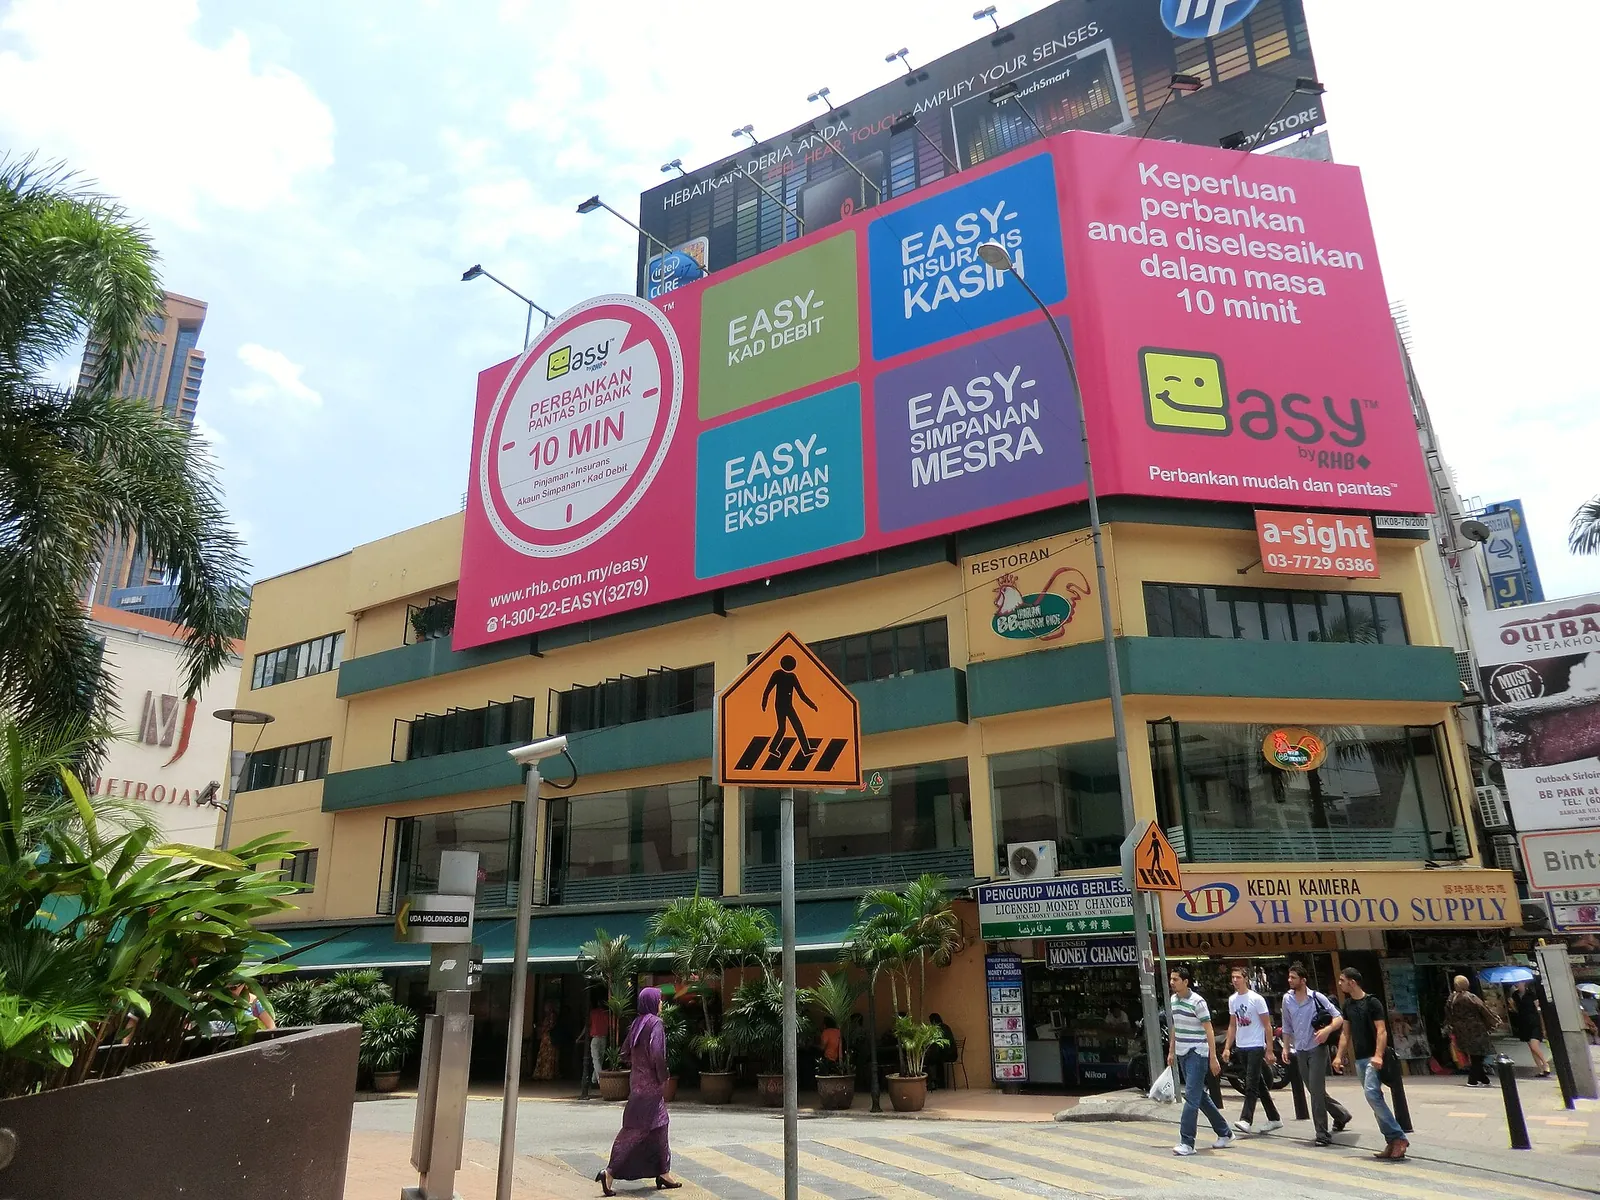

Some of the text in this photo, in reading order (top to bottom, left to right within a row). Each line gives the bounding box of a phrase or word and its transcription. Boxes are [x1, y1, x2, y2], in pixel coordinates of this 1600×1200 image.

[912, 77, 975, 115] AMPLIFY
[980, 54, 1027, 84] YOUR
[1033, 21, 1104, 62] SENSES.
[748, 146, 793, 175] DERIA
[798, 121, 853, 153] ANDA.
[1138, 162, 1296, 203] Keperluan
[901, 200, 1018, 266] EASY-
[1140, 197, 1305, 234] perbankan
[1088, 221, 1364, 270] anda diselesaikan
[903, 249, 1025, 319] KASIH
[1140, 253, 1326, 296] dalam masa
[728, 289, 824, 347] EASY-
[1177, 287, 1301, 324] 10 minit
[728, 316, 825, 367] KAD DEBIT
[528, 385, 632, 432] PANTAS DI BANK
[529, 366, 633, 419] PERBANKAN
[907, 364, 1036, 430] EASY-
[528, 411, 624, 470] 10 MIN
[910, 398, 1040, 454] SIMPANAN
[533, 457, 611, 489] Pinjaman Insurans
[725, 433, 828, 491] EASY-
[911, 426, 1044, 488] MESRA
[1298, 446, 1355, 470] by RHB
[516, 462, 628, 507] Akaun Simpanan Kad Debit
[725, 464, 829, 511] PINJAMAN
[1149, 465, 1238, 487] Perbankan
[1242, 475, 1299, 491] mudah
[1303, 477, 1333, 494] dan
[1337, 482, 1391, 497] pantas
[724, 486, 830, 533] EKSPRES
[1263, 518, 1371, 553] a-sight
[971, 548, 1050, 575] RESTORAN
[1267, 553, 1374, 572] 03-7729 6386
[490, 555, 649, 608] www.rhb.com.my/easy
[997, 614, 1018, 633] BB
[1497, 668, 1533, 690] MUST
[1505, 683, 1535, 702] TRY!
[1536, 773, 1571, 783] Outback
[1539, 787, 1599, 799] BB PARK at
[1562, 798, 1582, 806] TEL:
[1543, 848, 1600, 872] Bint
[985, 886, 1042, 901] PENGURUP
[1046, 883, 1079, 897] WANG
[1182, 888, 1226, 914] YH
[1247, 879, 1361, 896] KEDAI KAMERA
[423, 915, 454, 923] HOLDINGS
[995, 903, 1040, 915] LICENSED
[1046, 899, 1080, 912] MONEY
[1250, 897, 1508, 924] YH PHOTO SUPPLY
[1050, 940, 1086, 948] LICENSED
[1050, 945, 1138, 965] MONEY CHANGE
[1085, 1071, 1107, 1079] Nikon
